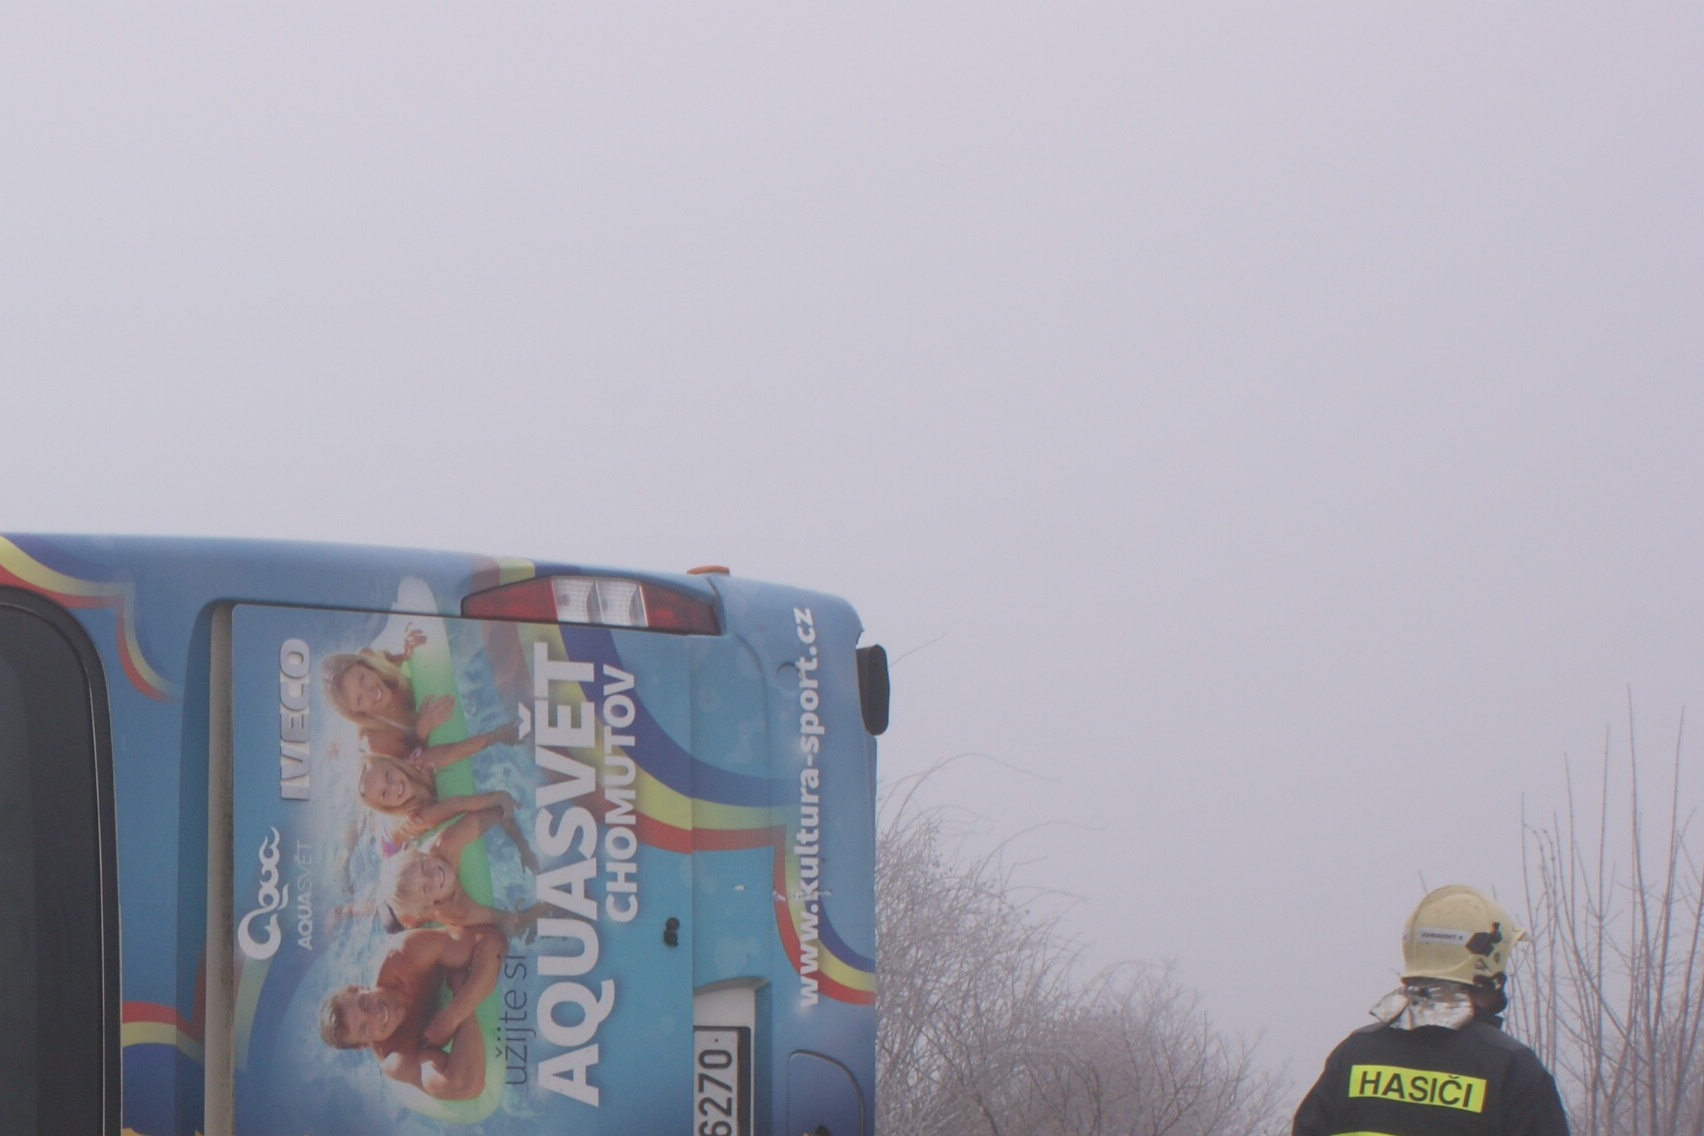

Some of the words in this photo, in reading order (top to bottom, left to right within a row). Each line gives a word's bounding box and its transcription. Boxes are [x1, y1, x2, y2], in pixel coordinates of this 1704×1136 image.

[279, 639, 310, 802] IVECO
[602, 664, 639, 923] CHOMUTOV
[794, 608, 825, 1007] www.kultura-sport.cz
[293, 840, 313, 951] AQUASVĚT
[519, 642, 615, 1107] AQUASVĚT
[500, 954, 527, 980] si
[495, 989, 535, 1085] užijte
[1358, 1070, 1474, 1109] HASIČI
